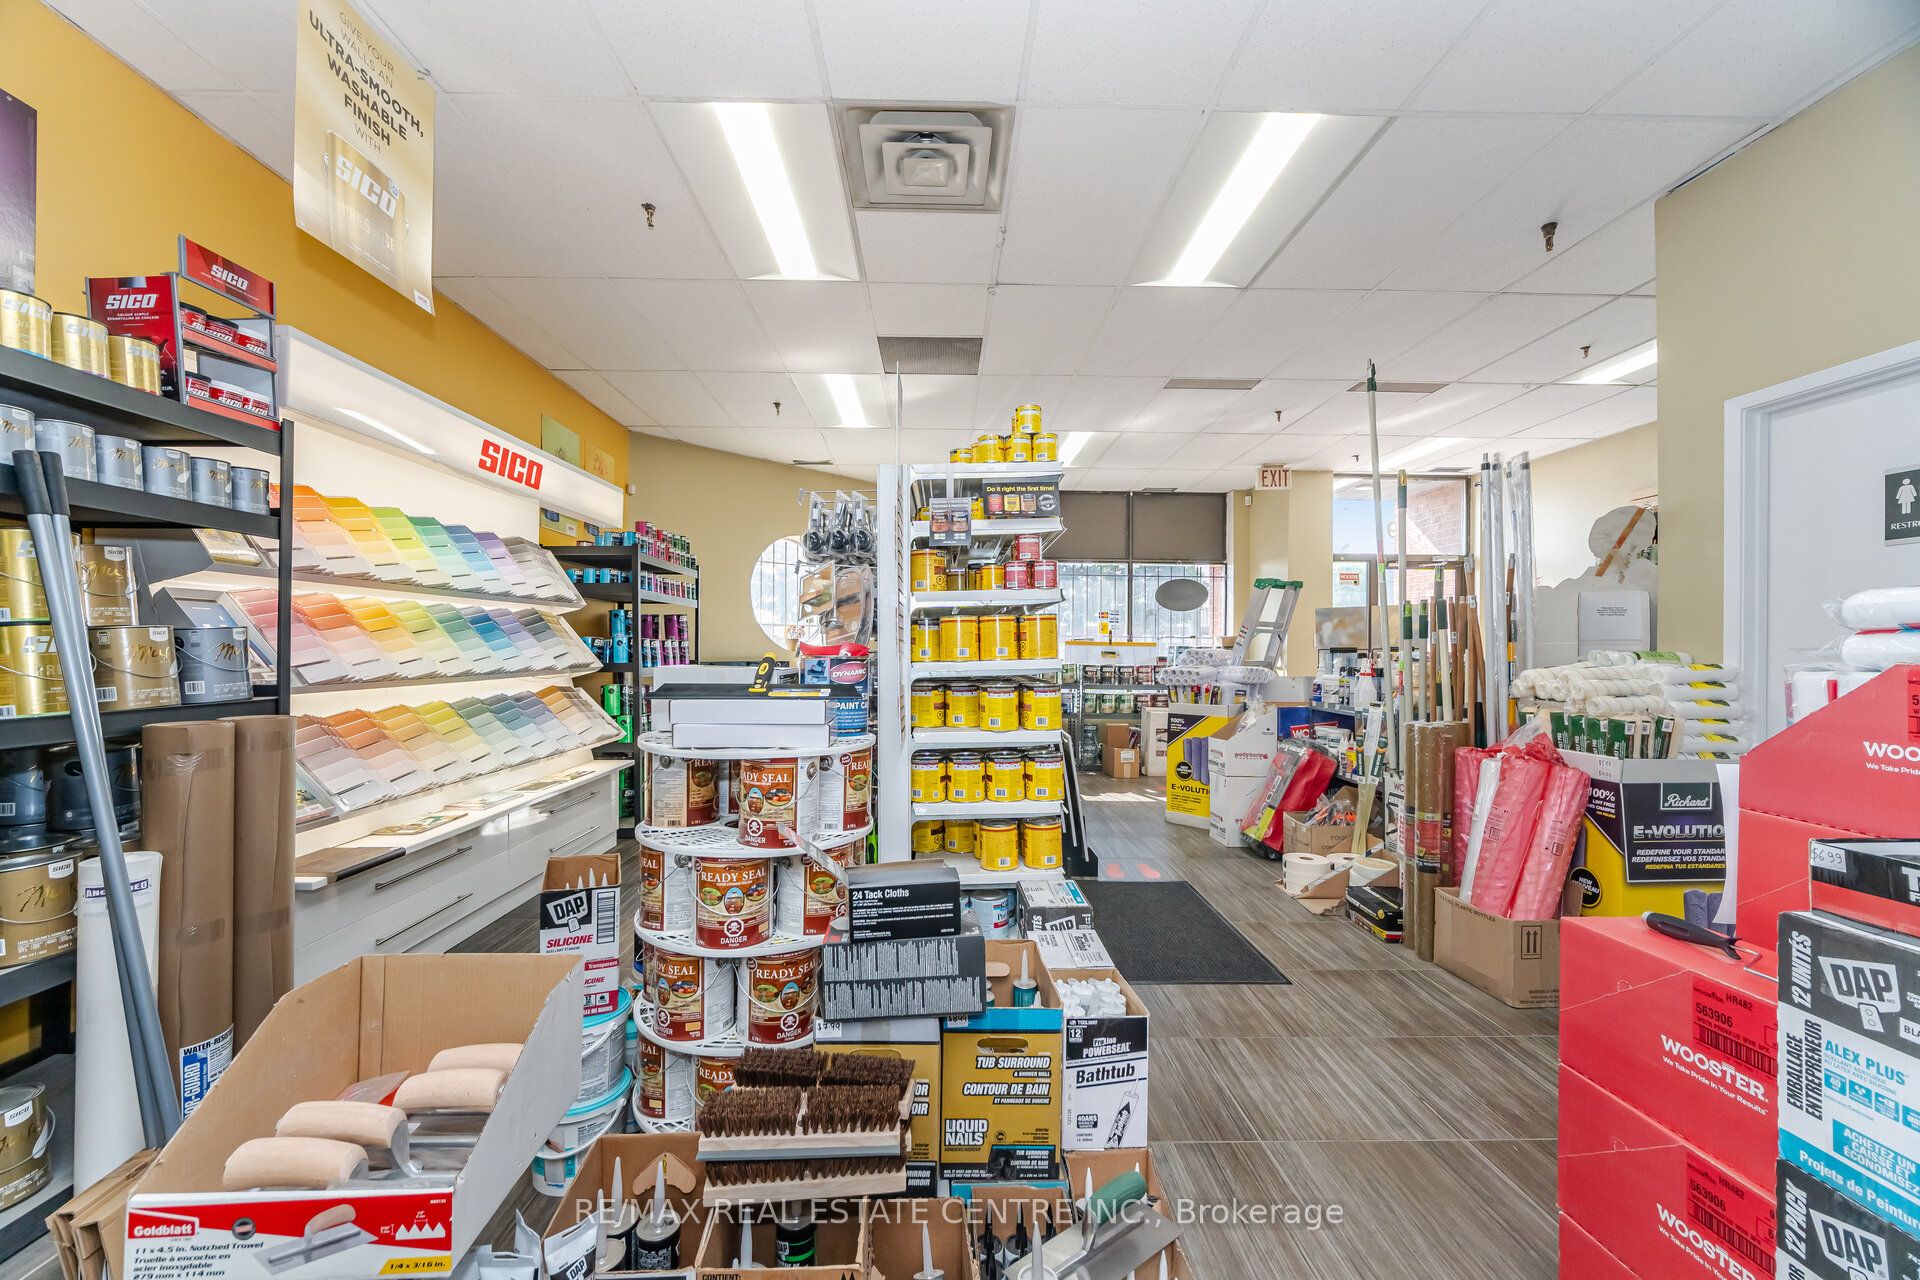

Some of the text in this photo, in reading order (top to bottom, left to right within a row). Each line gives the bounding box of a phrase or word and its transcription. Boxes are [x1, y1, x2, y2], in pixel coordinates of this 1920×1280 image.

[340, 12, 394, 74] GIVE YOUR
[341, 28, 393, 88] WALLS AN
[309, 10, 424, 137] ULTRA-SMOOTH,
[327, 53, 407, 140] WASHABLE
[344, 93, 390, 146] FINISH
[355, 124, 381, 154] WITH
[335, 154, 397, 219] SICO
[210, 264, 249, 291] SICO
[105, 293, 158, 310] SICO
[478, 438, 543, 490] SICO
[1262, 469, 1289, 488] EXIT
[831, 665, 867, 679] DYNAMIC
[1866, 762, 1900, 773] We Take
[762, 772, 791, 784] SEAL
[1588, 788, 1616, 802] 100%
[1664, 793, 1709, 808] Richard
[1633, 824, 1725, 839] E-VOLUTIO
[1811, 847, 1843, 864] $6.99
[52, 864, 72, 873] SICO
[701, 866, 767, 882] READY SEAL
[1578, 876, 1593, 886] NEW
[852, 888, 910, 900] 24 Tack Cloths
[552, 896, 586, 921] DAP
[546, 934, 594, 949] SILICONE
[720, 935, 748, 945] DANGER
[668, 963, 696, 976] SEAL
[756, 967, 797, 980] READY
[1788, 930, 1812, 1008] 12 UNITÉS
[1830, 964, 1893, 1002] DAP
[1726, 992, 1753, 1012] HR482
[1696, 1002, 1734, 1028] 563906
[776, 1028, 802, 1040] DANGER
[816, 1023, 841, 1032] $7.99
[1070, 1030, 1082, 1038] 12
[1082, 1042, 1130, 1058] POWERSEAL
[976, 1056, 1050, 1068] TUB SURROUND
[1804, 1019, 1823, 1121] ENTREPRENEUR
[1824, 1040, 1906, 1086] ALEX PLUS
[700, 1067, 734, 1081] READY
[1076, 1062, 1136, 1084] Bathtub
[1786, 1032, 1803, 1111] EMBALLAGE
[1852, 1072, 1868, 1083] AVEC
[964, 1083, 1050, 1095] CONTOUR DE BAIN
[1662, 1056, 1766, 1115] We Take Pride In Your Results
[9, 1106, 30, 1120] SICO
[946, 1119, 988, 1132] LIQUID
[946, 1132, 984, 1146] NAILS
[1844, 1128, 1916, 1174] ACHETEZ UN
[1852, 1141, 1910, 1180] CAISSE ET
[1800, 1150, 1844, 1185] Projets
[1846, 1180, 1863, 1196] de
[1844, 1144, 1920, 1196] ÉCONOMISEZ
[1690, 1178, 1727, 1212] 563906
[1785, 1178, 1807, 1260] 12 PACK
[134, 1224, 192, 1236] Goldblatt
[190, 1243, 230, 1252] Notched
[232, 1242, 264, 1250] Trowel
[1658, 1224, 1712, 1271] We Take Pride In
[1820, 1220, 1883, 1273] DAP
[159, 1262, 213, 1272] inoxydable
[569, 1260, 586, 1280] DAP
